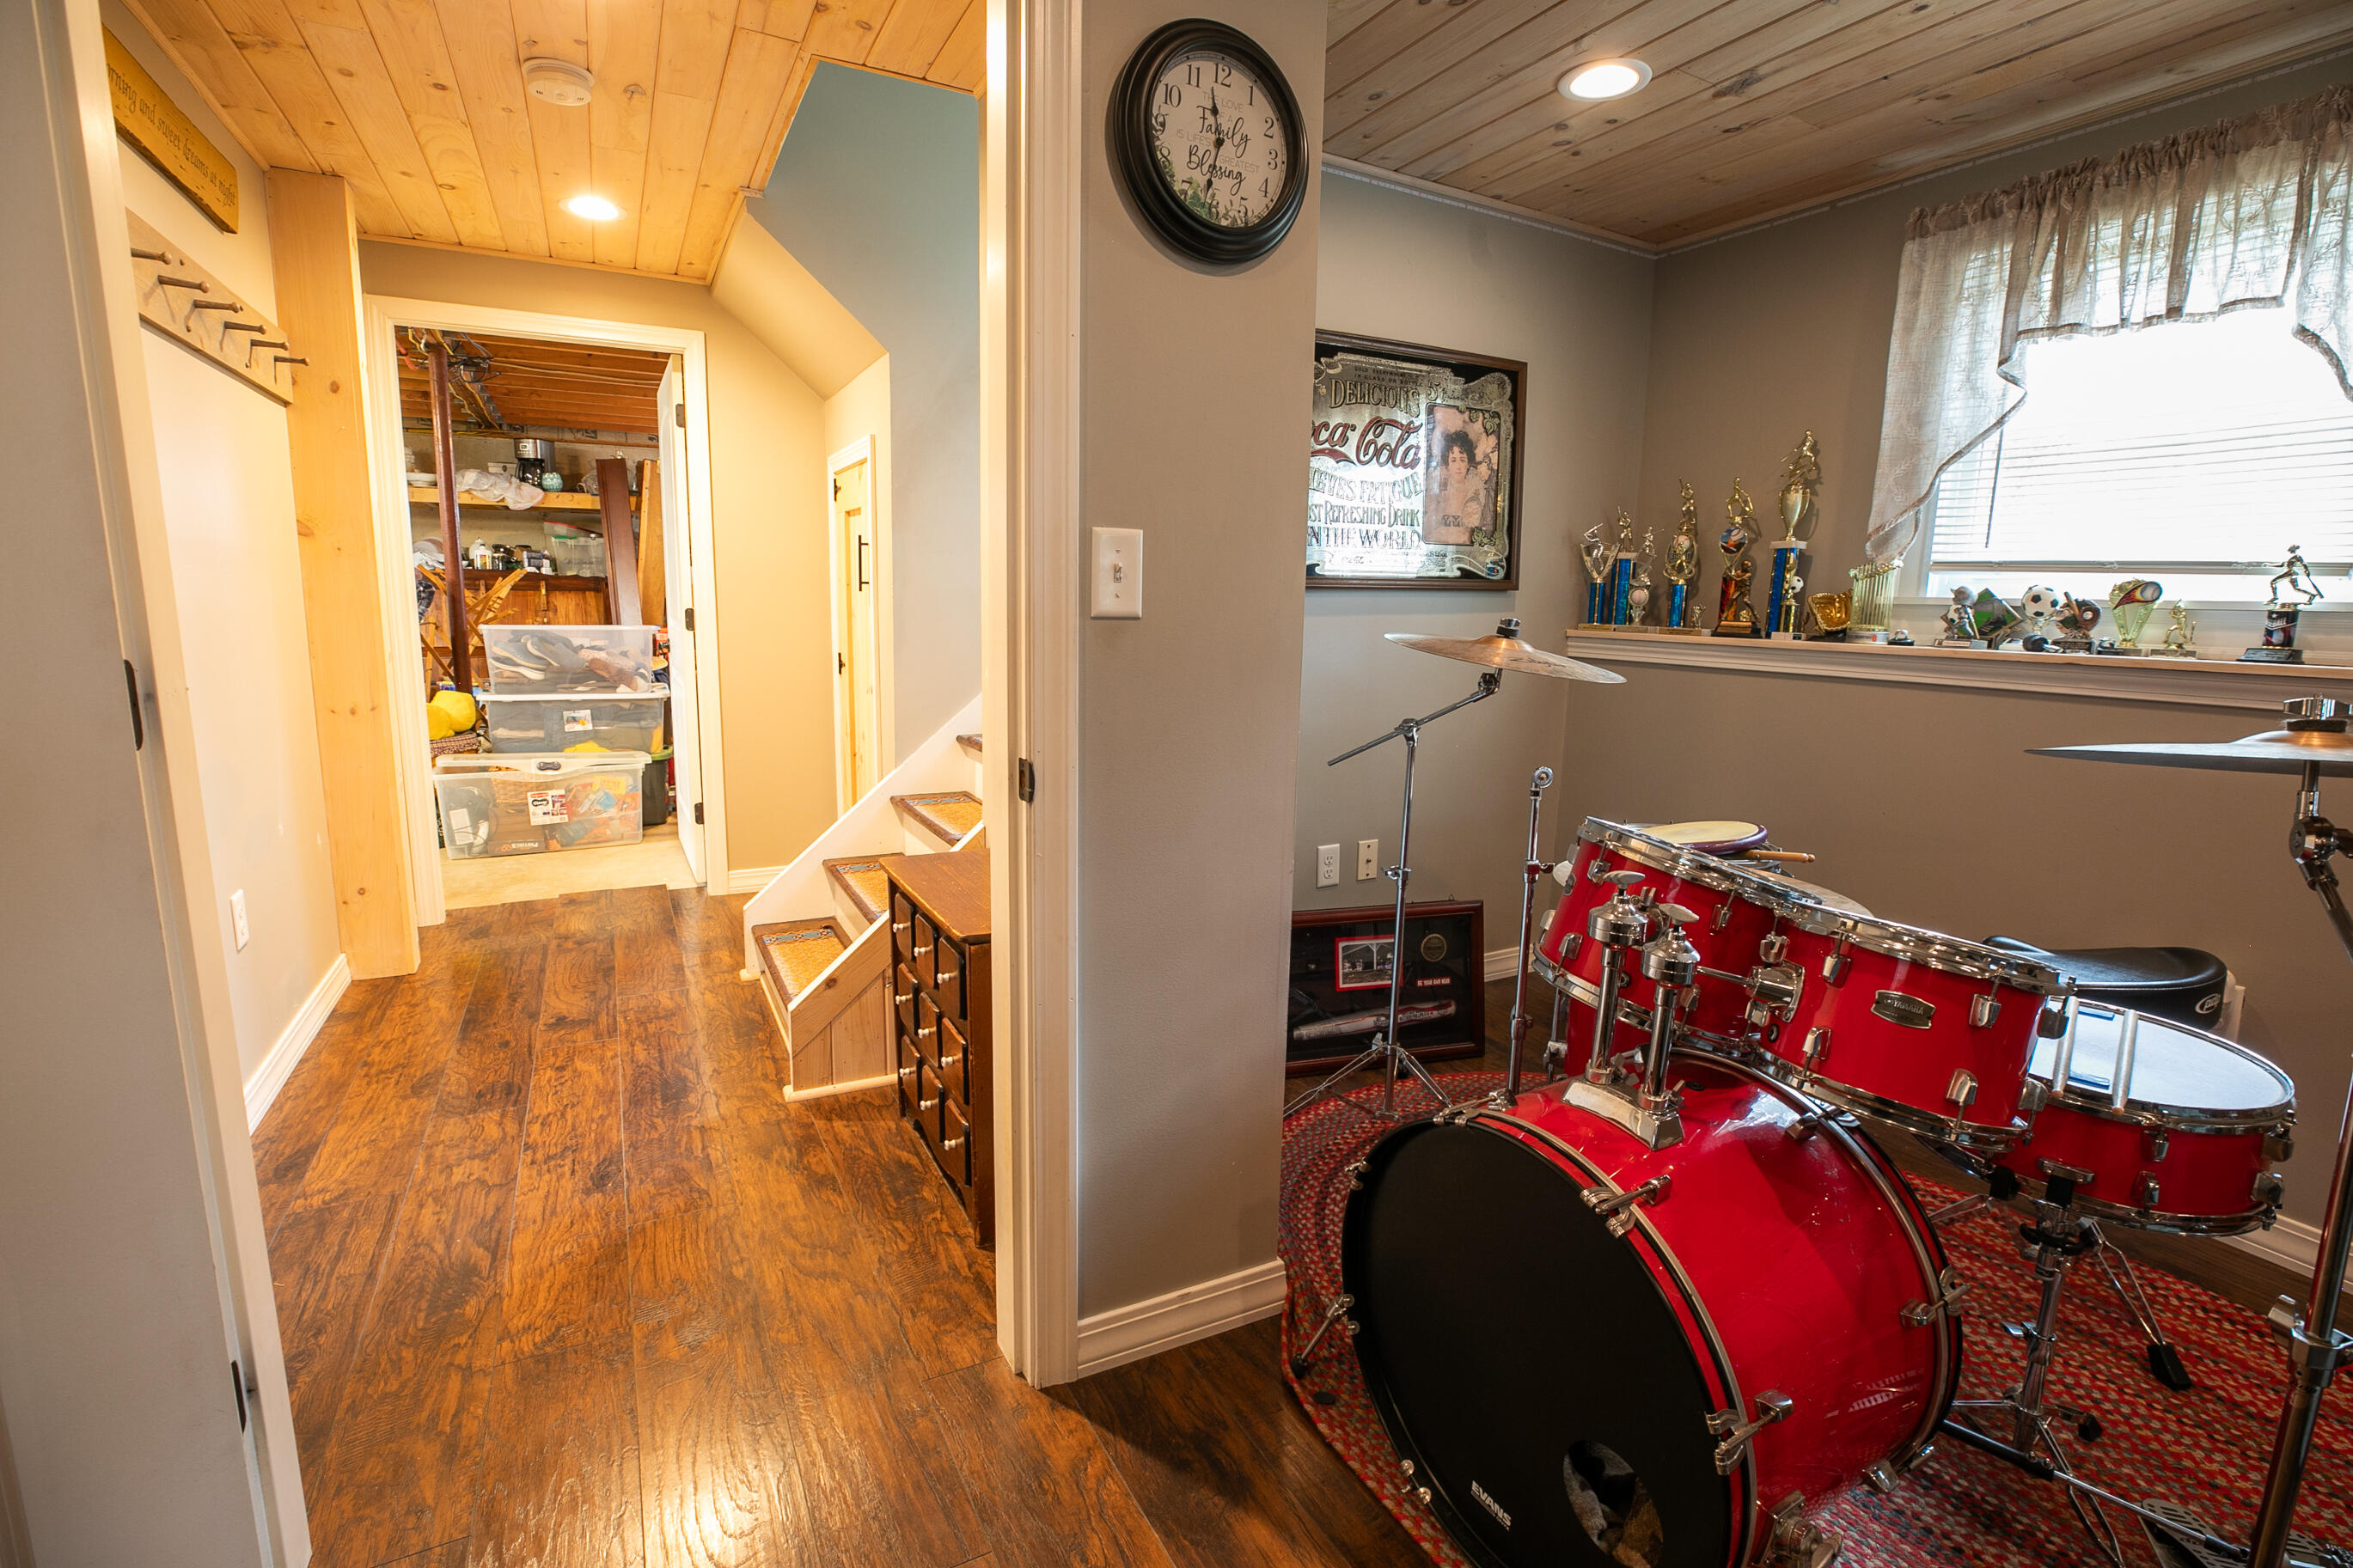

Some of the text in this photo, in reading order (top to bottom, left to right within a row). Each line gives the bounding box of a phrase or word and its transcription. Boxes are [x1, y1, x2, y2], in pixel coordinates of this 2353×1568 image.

[1185, 64, 1201, 88] 11
[1213, 62, 1232, 88] 12
[1162, 82, 1182, 108] 10
[1202, 91, 1244, 113] THE LOVE
[1247, 85, 1255, 107] 1
[1154, 113, 1166, 136] 9
[1227, 115, 1233, 124] A
[1264, 117, 1274, 138] 2
[1176, 129, 1184, 139] IS
[1196, 105, 1252, 159] Family
[139, 99, 157, 125] and
[158, 117, 181, 151] sweet
[183, 137, 209, 179] dreams
[210, 171, 218, 187] at
[218, 178, 235, 207] night
[1159, 145, 1171, 168] 8
[1219, 155, 1261, 173] GREATEST
[1268, 149, 1279, 170] 3
[1187, 144, 1246, 196] Blessing
[1180, 180, 1193, 203] 7
[1258, 176, 1269, 198] 4
[1208, 199, 1219, 221] 6
[1238, 196, 1249, 218] 5
[1329, 378, 1421, 418] DELICIOUS
[1360, 472, 1424, 504] FATIGUE
[1308, 501, 1421, 528] ST REFRESHING DRINK
[1323, 527, 1356, 548] THE
[1893, 998, 1924, 1015] YAMAHA
[1471, 1480, 1512, 1527] EVANS
